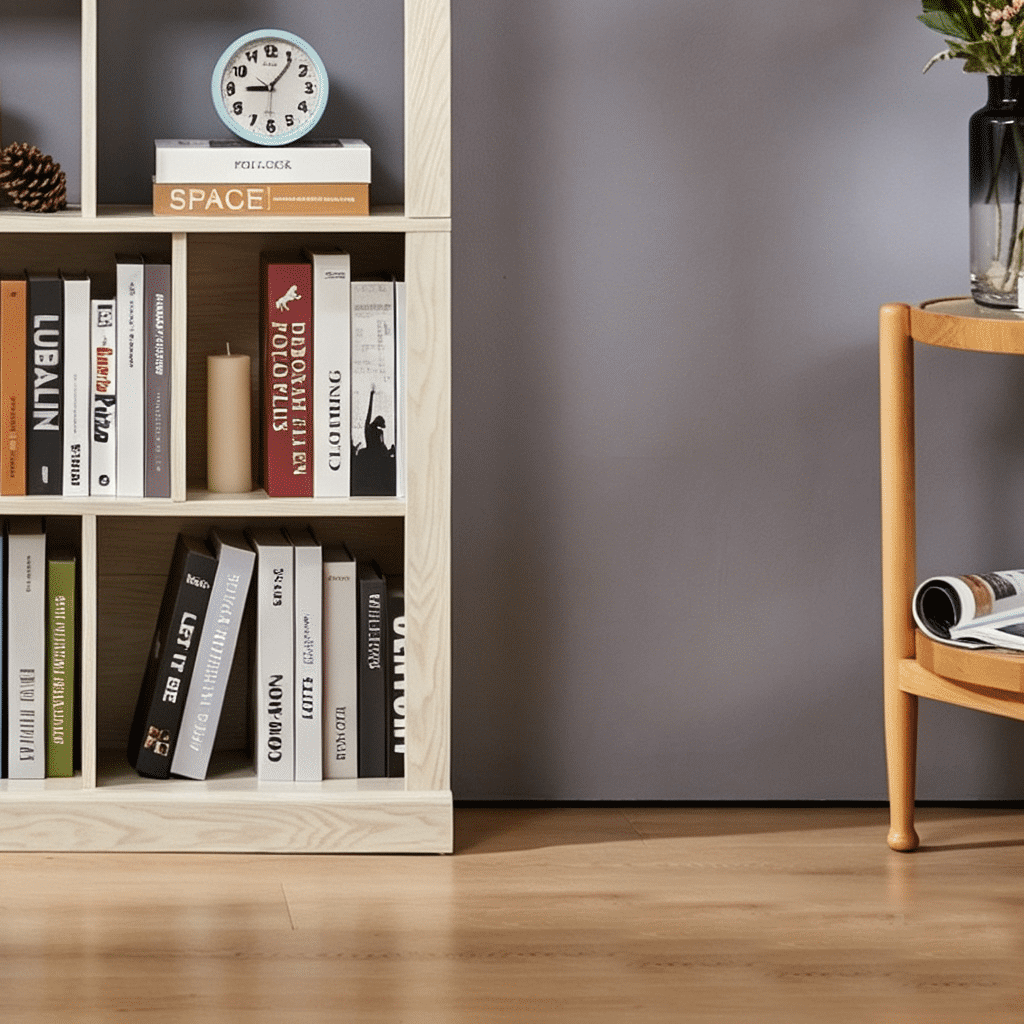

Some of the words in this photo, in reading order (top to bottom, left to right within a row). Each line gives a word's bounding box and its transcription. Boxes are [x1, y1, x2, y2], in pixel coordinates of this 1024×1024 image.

[233, 65, 248, 78] 10
[298, 64, 308, 78] 2
[304, 81, 314, 95] 3
[297, 100, 308, 114] 4
[249, 114, 258, 126] 7
[265, 119, 276, 133] 6
[285, 114, 294, 127] 5
[169, 188, 265, 211] SPACE
[32, 314, 60, 431] LUBALIN
